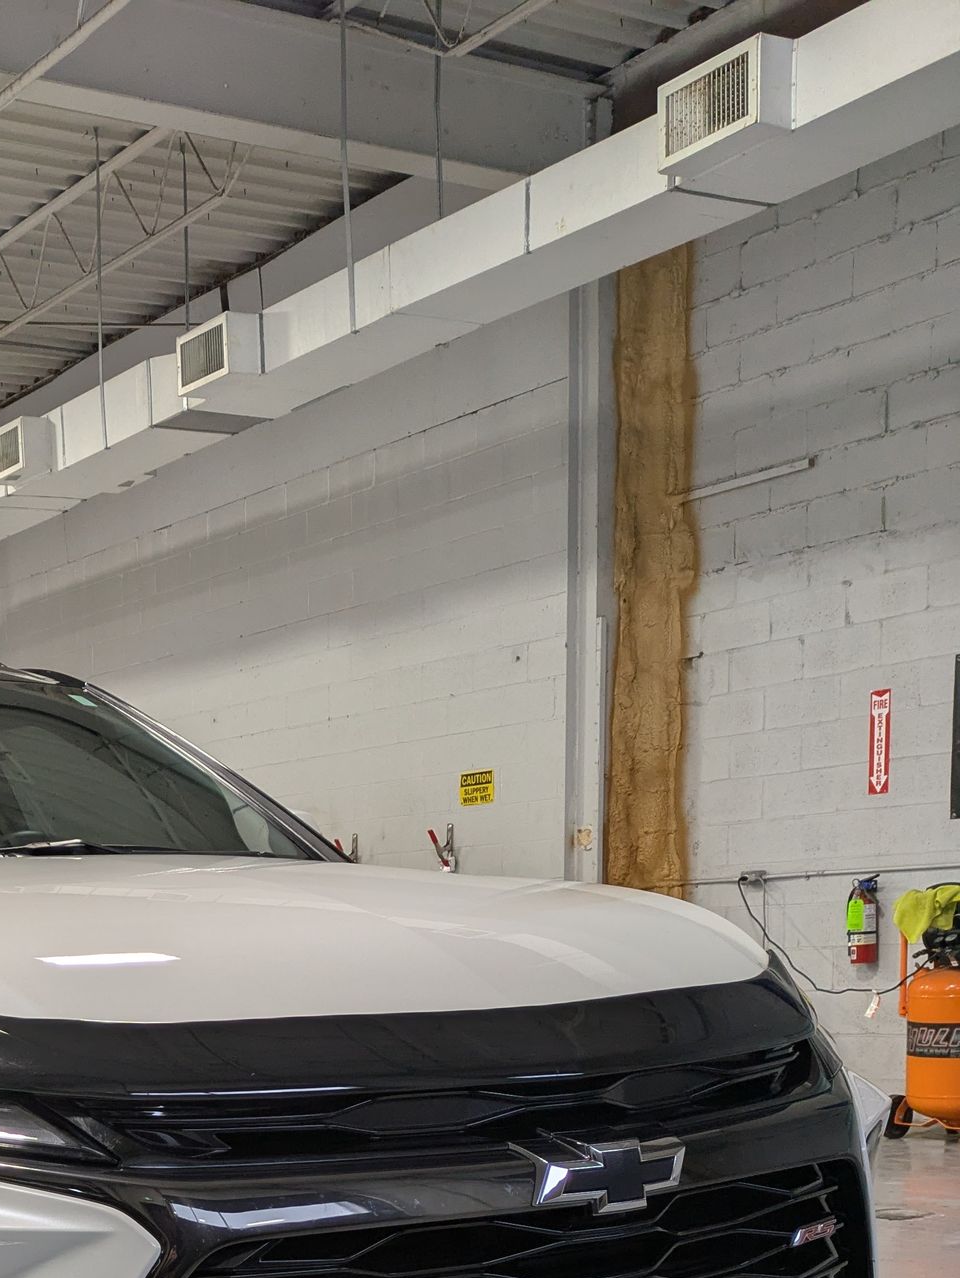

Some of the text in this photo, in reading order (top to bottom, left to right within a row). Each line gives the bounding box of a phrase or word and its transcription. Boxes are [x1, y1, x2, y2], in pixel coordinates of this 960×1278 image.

[873, 699, 888, 710] FIRE
[876, 713, 884, 786] EXTINGUISHER
[462, 773, 491, 786] CAUTION
[464, 786, 488, 795] SLIPPERY
[463, 794, 491, 803] WHEN WET
